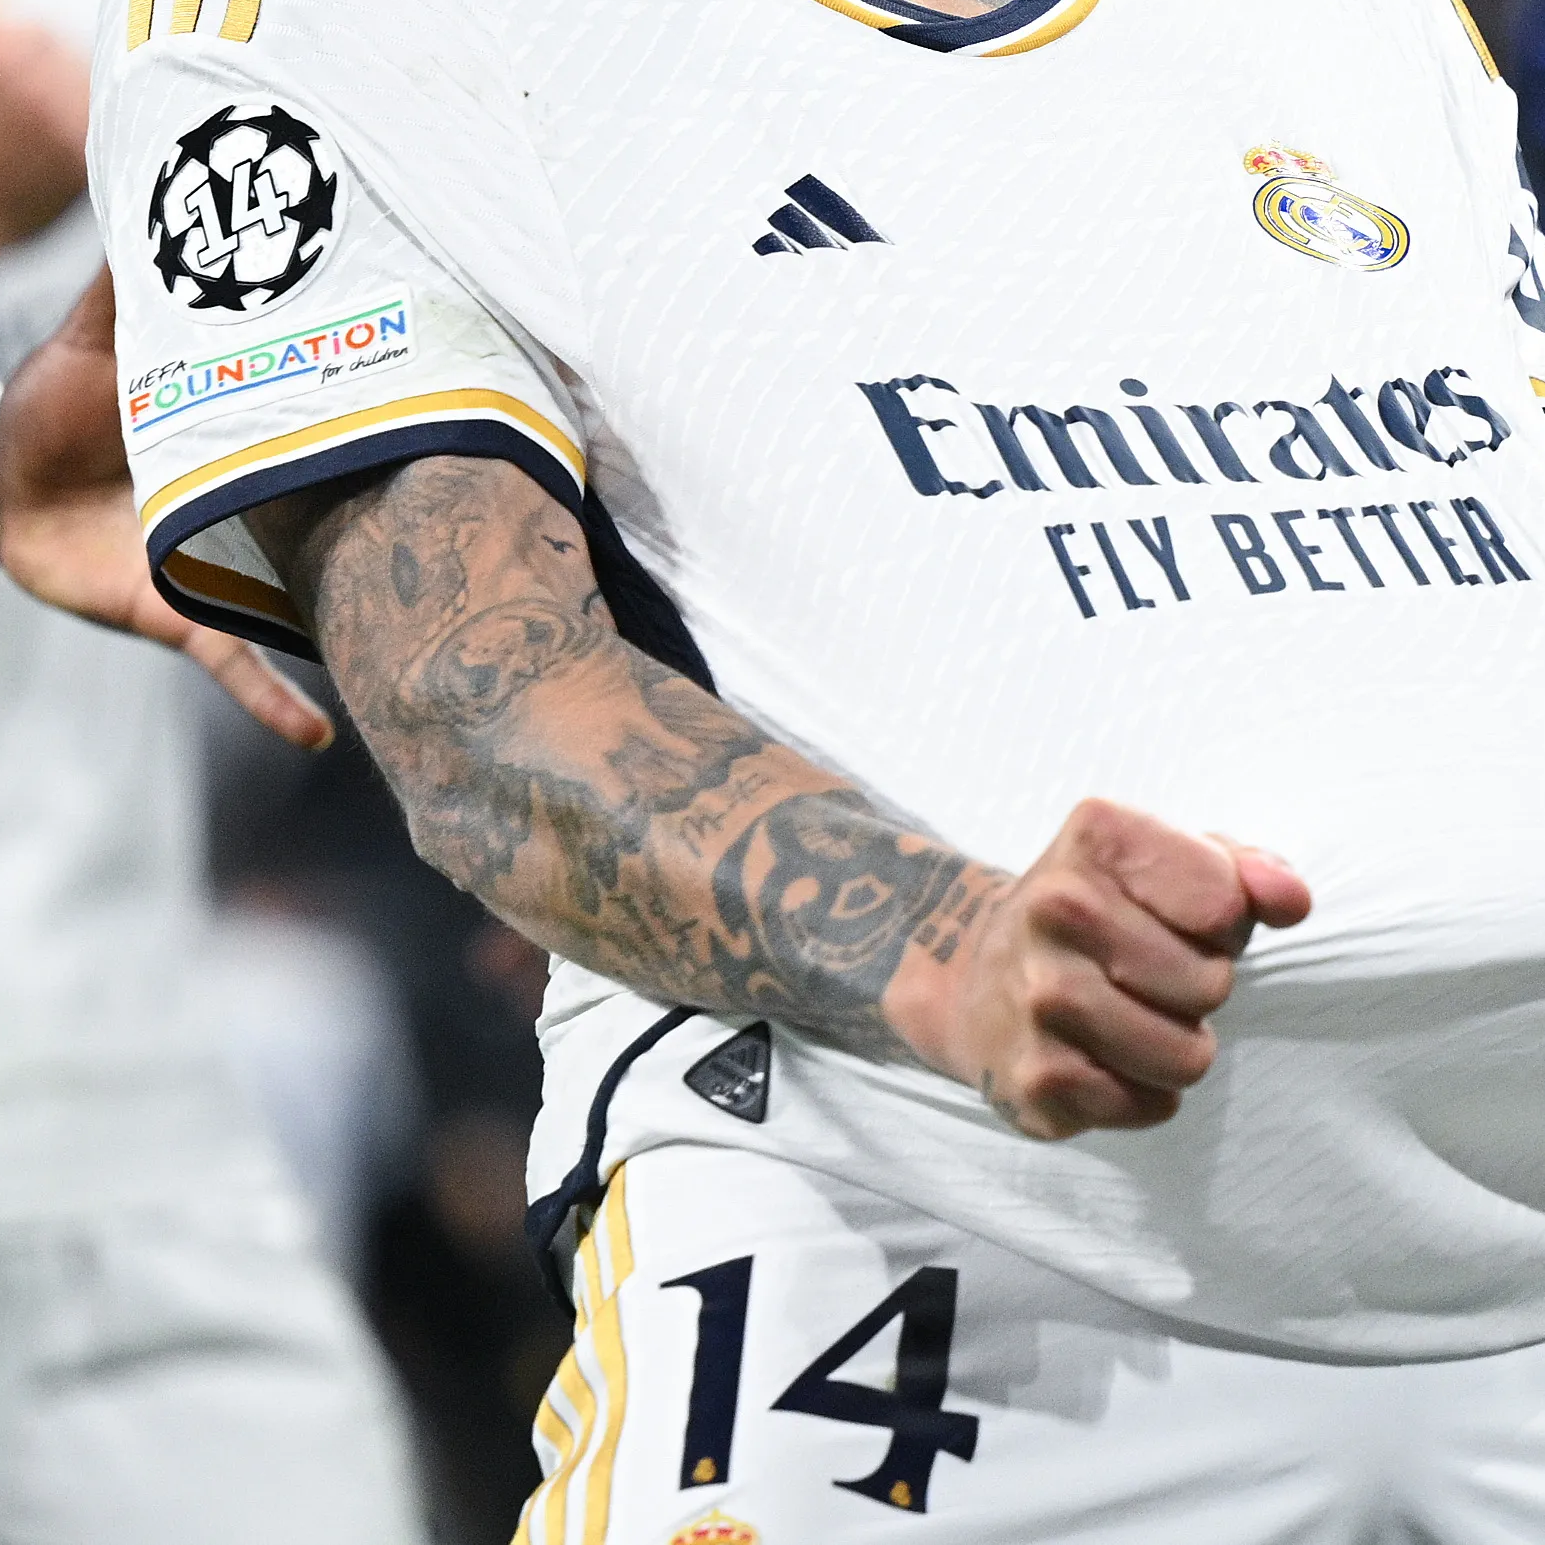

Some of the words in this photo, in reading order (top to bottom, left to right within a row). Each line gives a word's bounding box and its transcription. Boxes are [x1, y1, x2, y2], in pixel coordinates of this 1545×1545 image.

[185, 158, 289, 268] 14
[128, 359, 188, 395] UEFA
[129, 309, 407, 423] FOUNDATION
[321, 362, 343, 384] for
[349, 346, 409, 372] children
[854, 365, 1512, 498] Emirates
[1044, 516, 1193, 619] FLY
[1213, 497, 1532, 596] BETTER
[660, 1255, 979, 1514] 14
